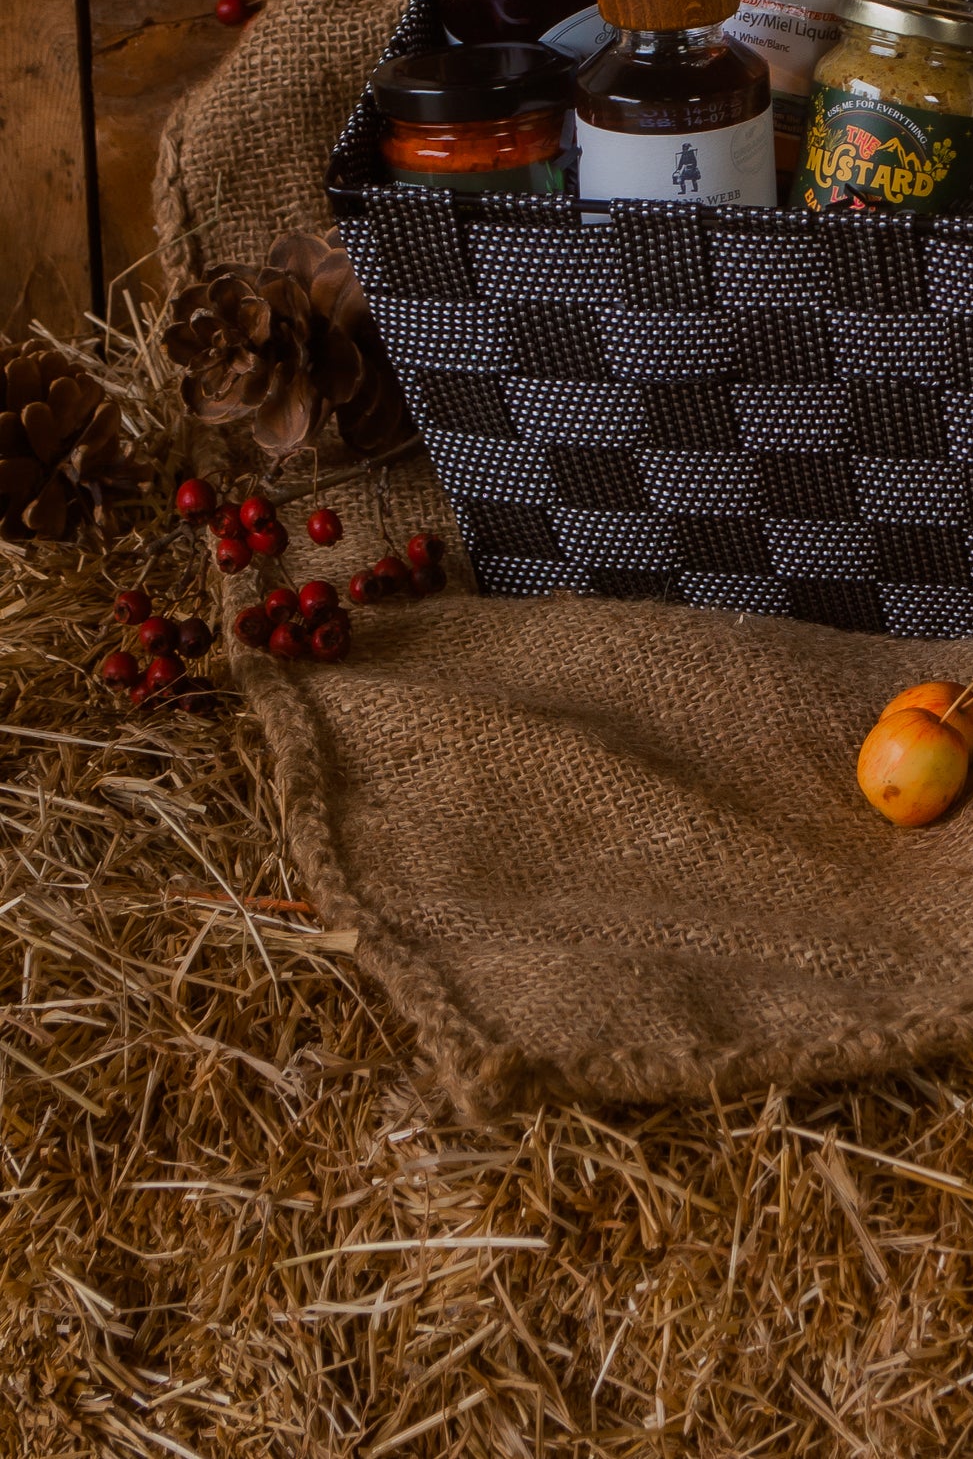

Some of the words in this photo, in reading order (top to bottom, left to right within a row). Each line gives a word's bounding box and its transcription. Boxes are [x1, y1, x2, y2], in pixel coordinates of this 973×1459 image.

[734, 10, 792, 33] ney/Miel
[740, 32, 790, 52] White/Blanc
[842, 100, 854, 109] ME
[856, 99, 874, 110] FOR
[846, 125, 883, 160] THE
[806, 143, 935, 204] MUSTARD
[707, 190, 741, 205] WEBB
